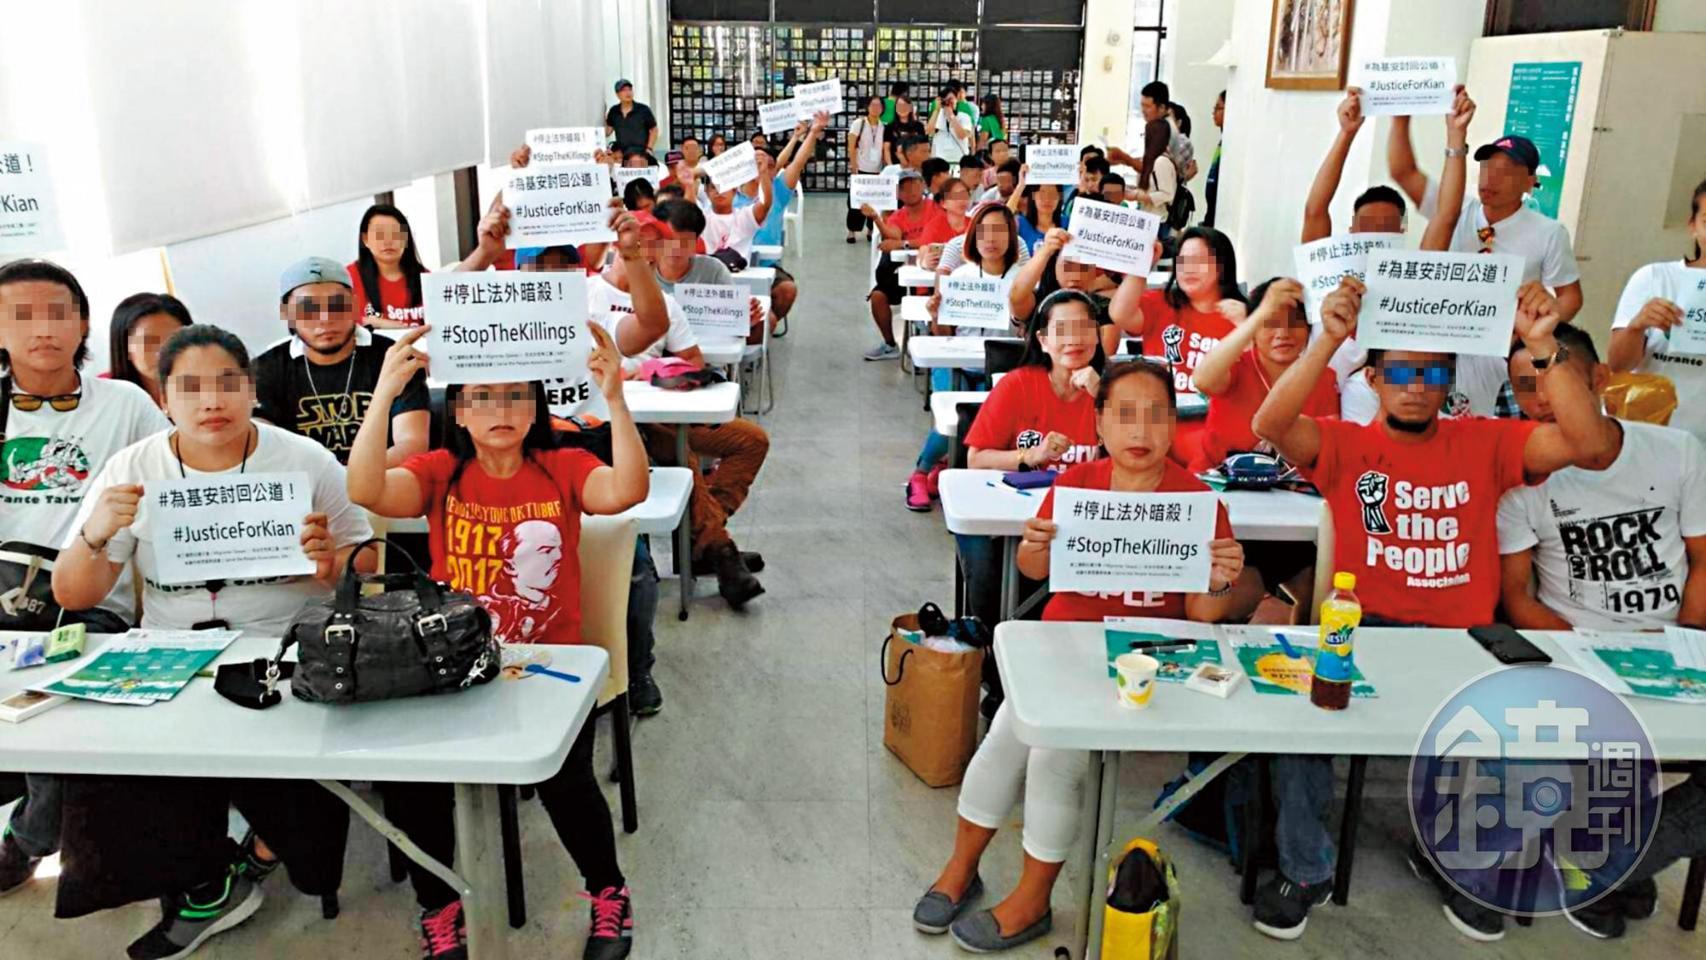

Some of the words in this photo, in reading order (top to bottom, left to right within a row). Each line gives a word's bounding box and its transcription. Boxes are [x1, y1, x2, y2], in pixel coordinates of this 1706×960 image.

[1370, 80, 1445, 91] #JusticeForKian
[0, 152, 33, 174] 道！
[516, 202, 601, 218] #JusticeForKian
[1078, 228, 1144, 252] #JusticeForKian
[1378, 260, 1508, 283] #為基安討回公道！
[443, 281, 564, 305] #停止法外暗殺！
[682, 303, 743, 319] #StopTheKillings
[1379, 297, 1497, 317] #JusticeForKian
[442, 321, 576, 347] #StopTheKillings
[159, 482, 295, 508] #為基安討回公道！
[1395, 480, 1470, 510] Serve
[1073, 501, 1192, 522] #停止法外暗殺！
[174, 520, 295, 543] #JusticeForKian
[447, 515, 502, 555] 1917
[1396, 512, 1459, 541] the
[1559, 511, 1662, 555] ROCK
[1067, 536, 1198, 560] #StopTheKillings
[1367, 535, 1470, 577] People
[1589, 543, 1666, 581] ROLL
[1609, 583, 1680, 613] 1979
